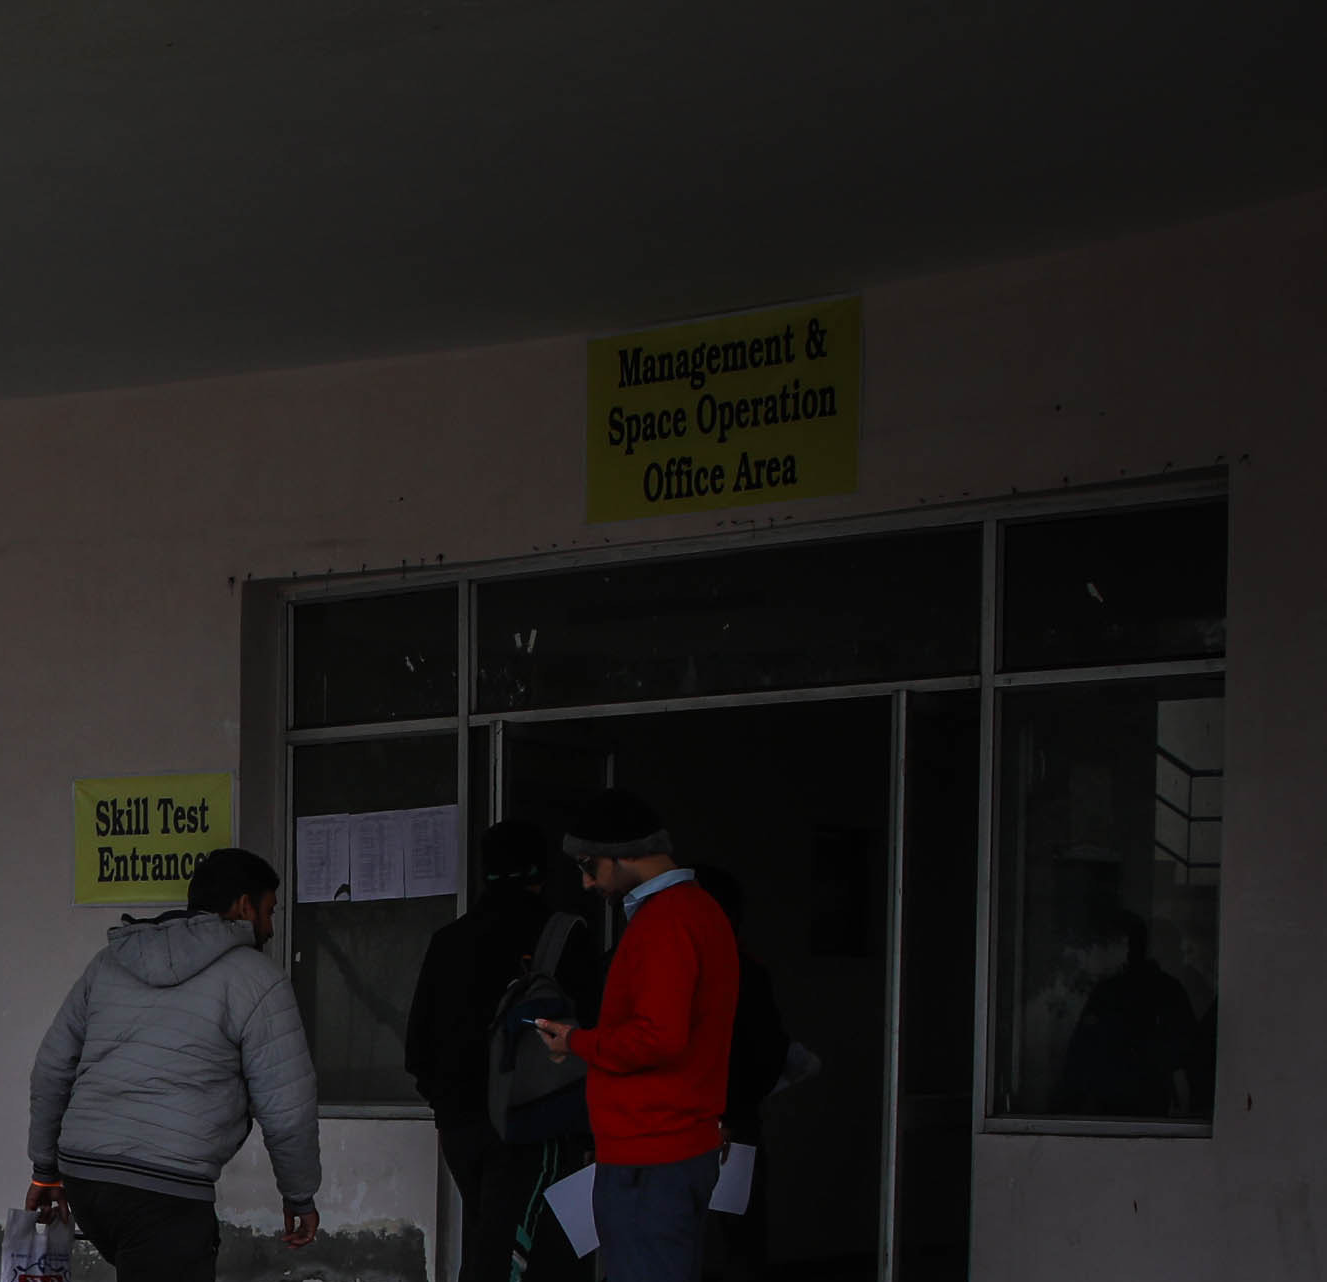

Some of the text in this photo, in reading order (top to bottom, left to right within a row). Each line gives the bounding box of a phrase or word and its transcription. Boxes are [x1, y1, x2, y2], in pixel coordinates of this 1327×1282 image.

[617, 317, 828, 390] Management &
[608, 379, 838, 456] Space Operation
[643, 452, 798, 502] Office Area
[95, 797, 210, 837] Skill Test
